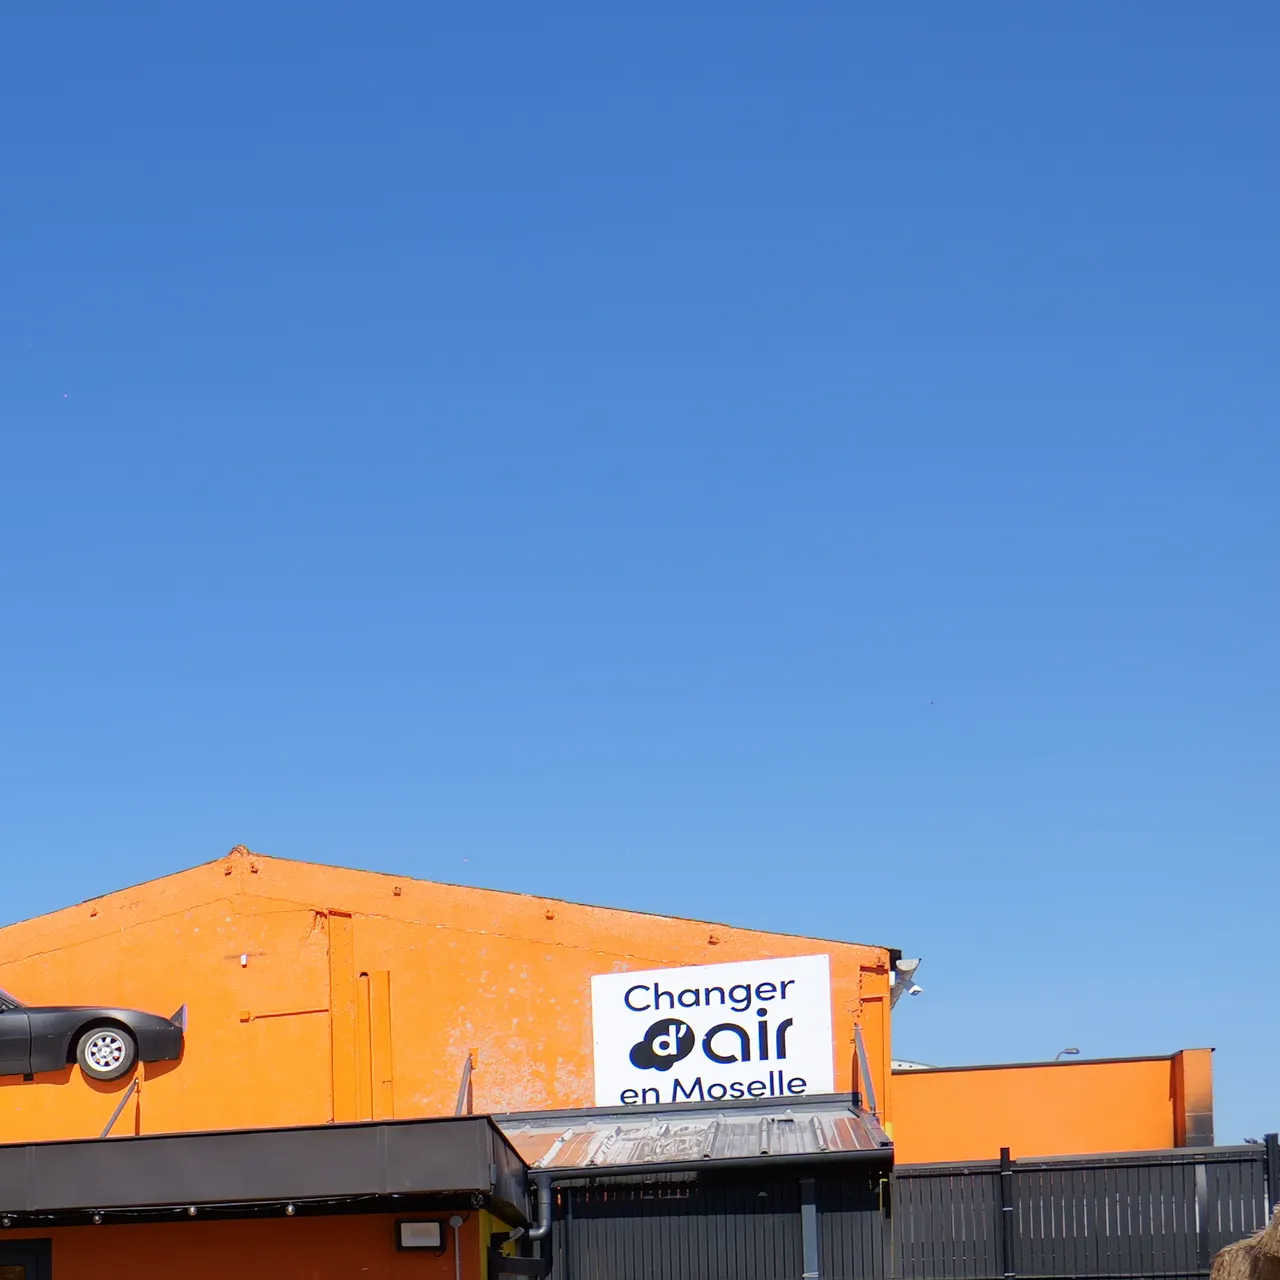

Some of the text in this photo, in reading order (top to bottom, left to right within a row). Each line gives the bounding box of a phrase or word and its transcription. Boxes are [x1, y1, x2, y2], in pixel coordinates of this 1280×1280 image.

[624, 980, 795, 1012] Changer
[620, 1070, 807, 1105] en Moselle
